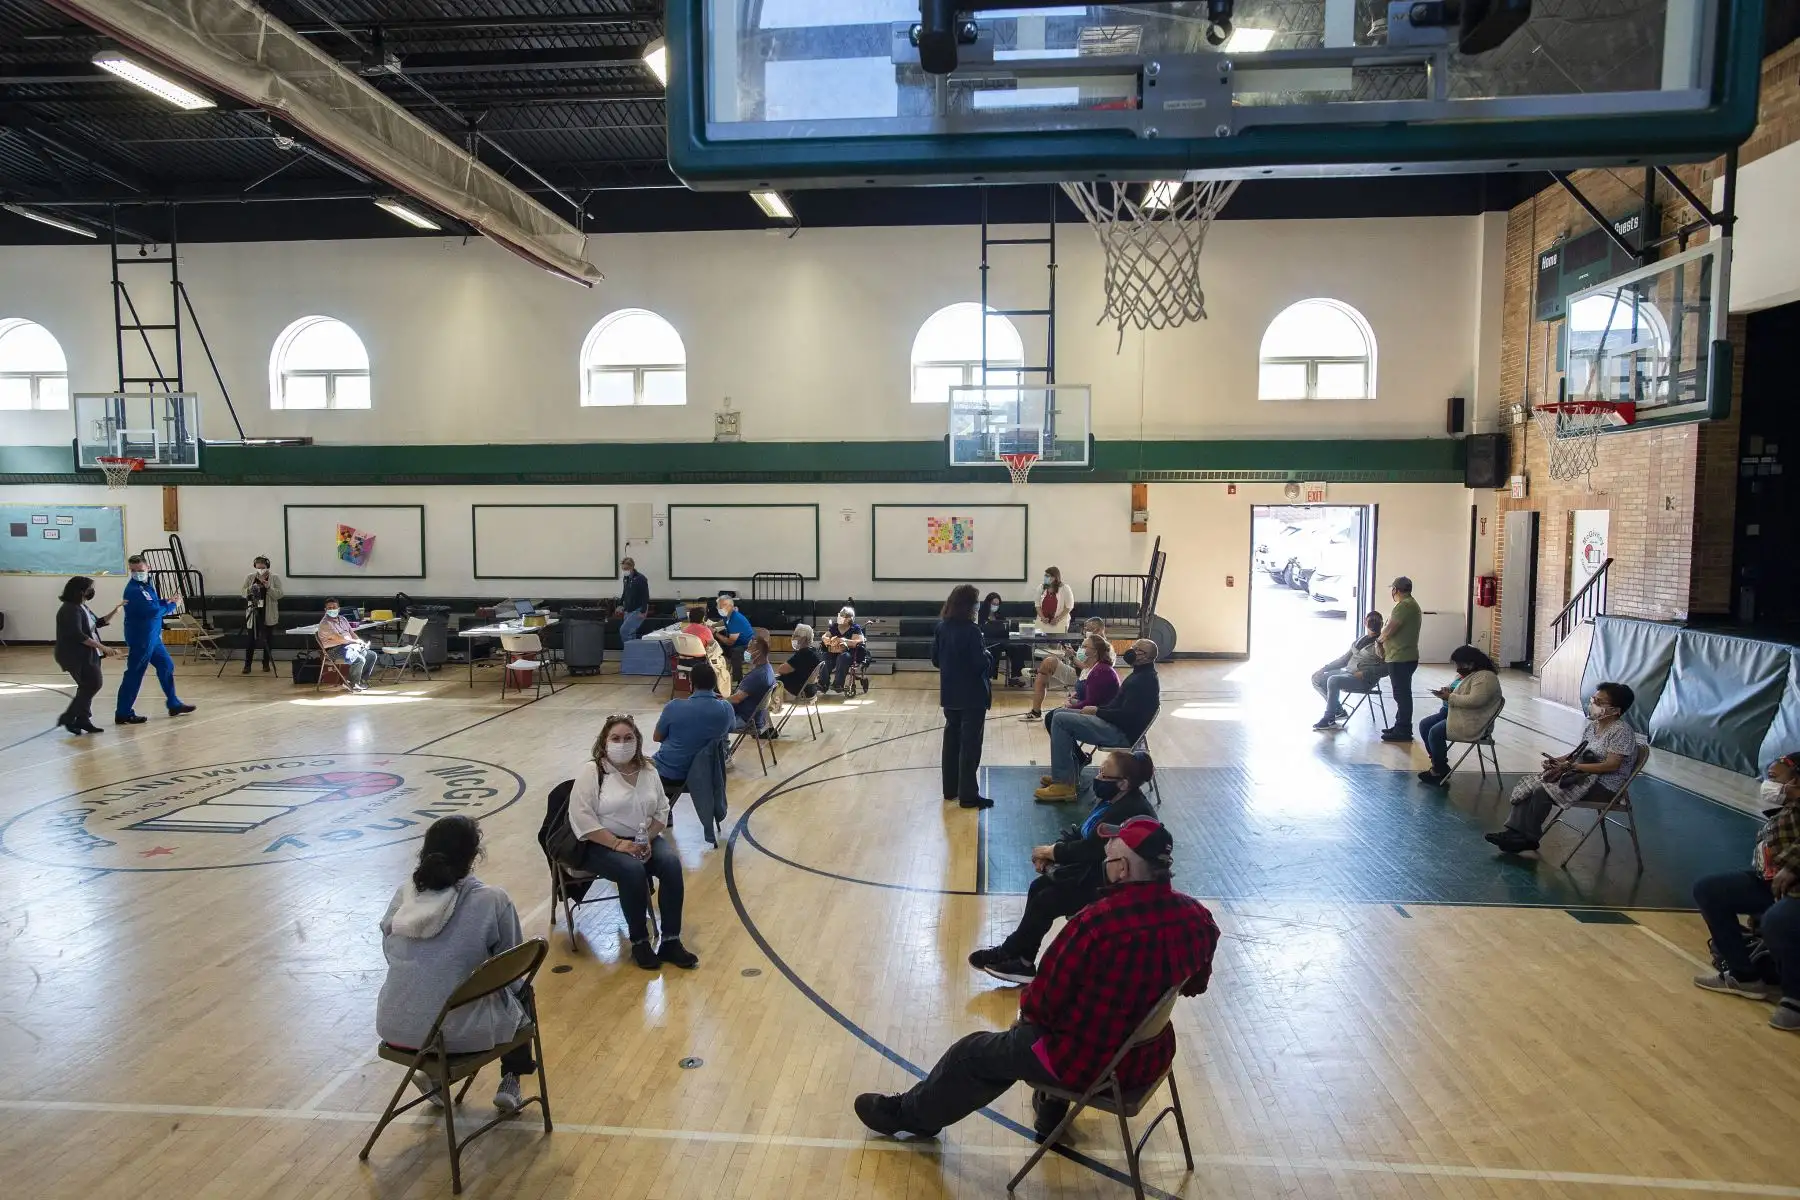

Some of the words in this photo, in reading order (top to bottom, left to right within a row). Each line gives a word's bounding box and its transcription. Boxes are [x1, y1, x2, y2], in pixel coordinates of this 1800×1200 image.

[1614, 216, 1639, 236] Guests
[1541, 254, 1558, 270] Home
[1307, 490, 1323, 502] EXIT
[82, 759, 336, 806] COMMUNITY
